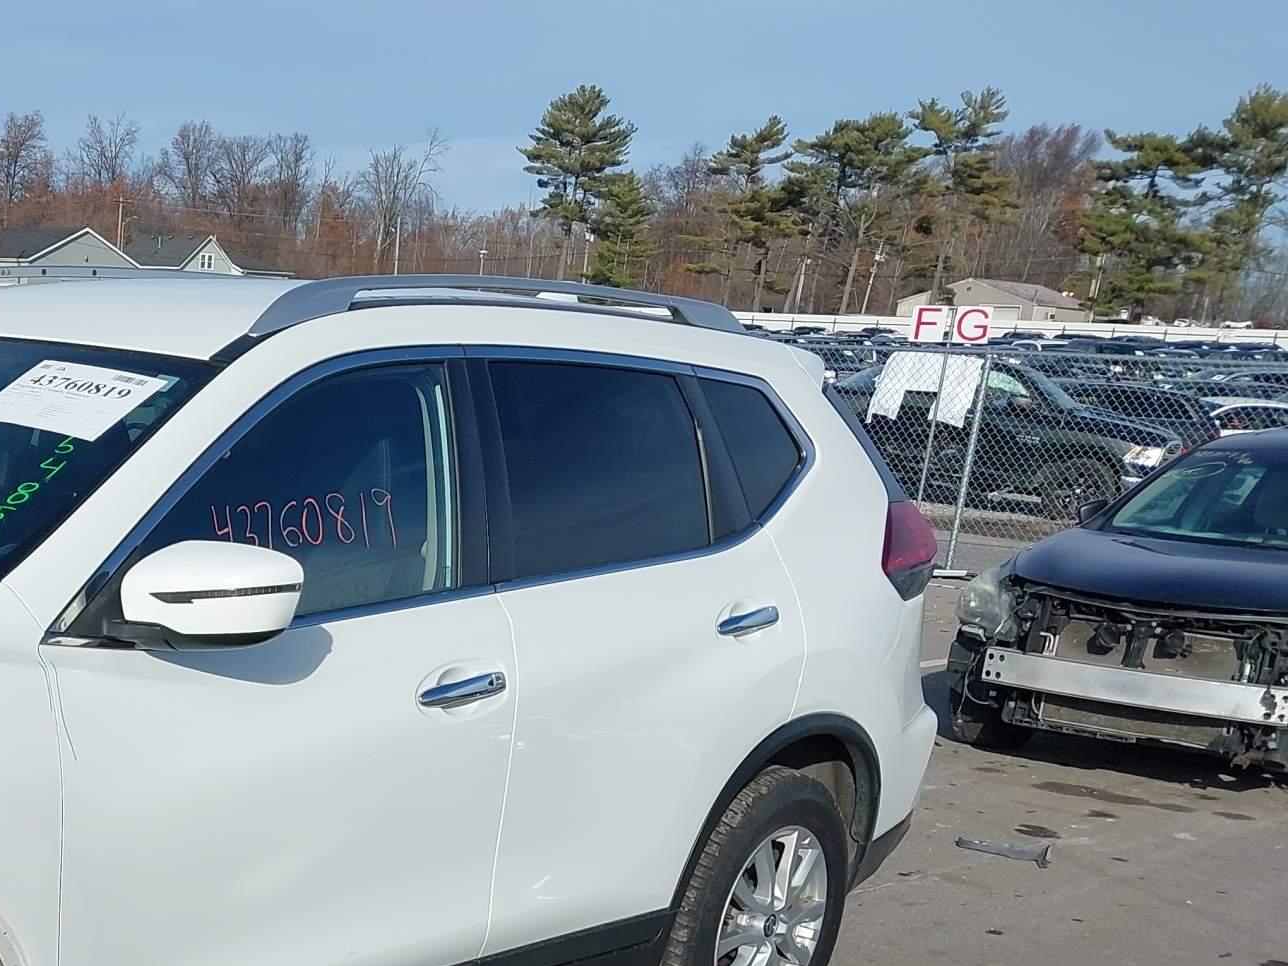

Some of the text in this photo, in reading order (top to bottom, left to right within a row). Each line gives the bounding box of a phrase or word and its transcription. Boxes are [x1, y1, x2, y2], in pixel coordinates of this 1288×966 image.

[913, 307, 991, 342] F G
[29, 373, 133, 400] 43760819
[213, 488, 395, 547] 43760819
